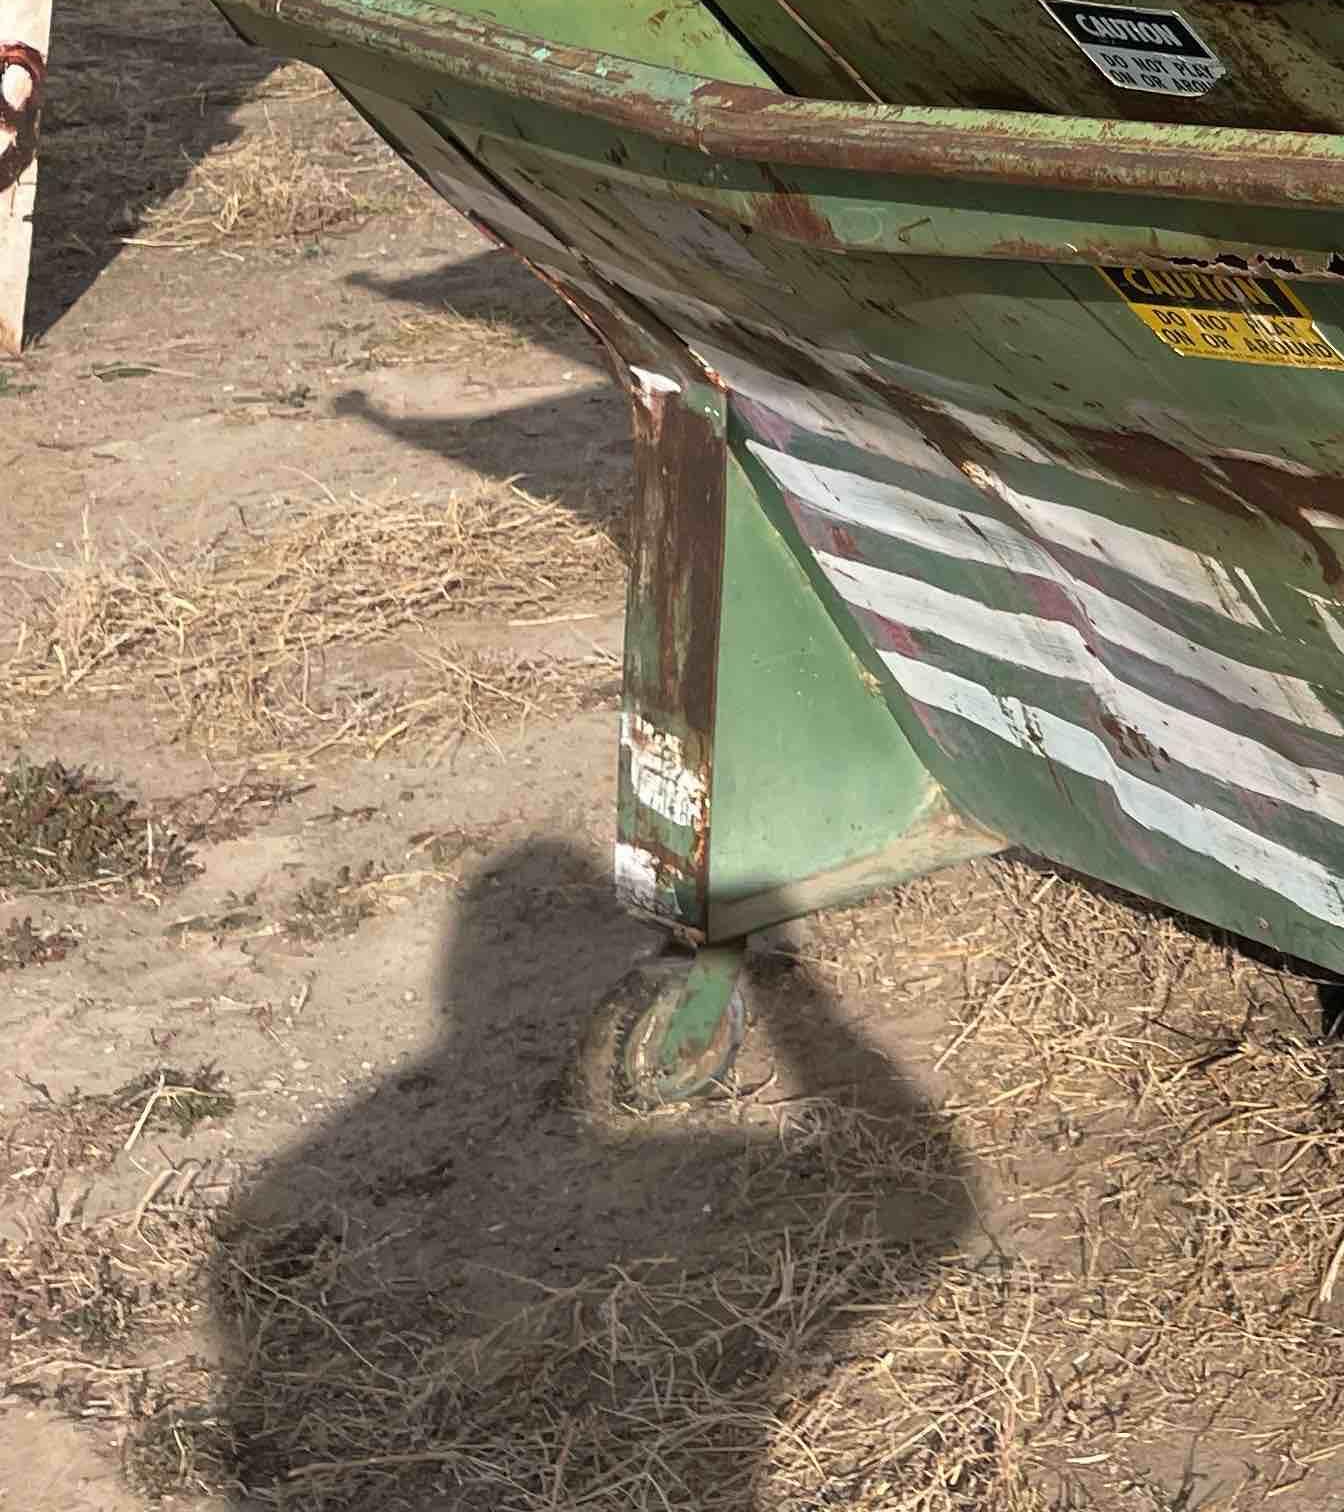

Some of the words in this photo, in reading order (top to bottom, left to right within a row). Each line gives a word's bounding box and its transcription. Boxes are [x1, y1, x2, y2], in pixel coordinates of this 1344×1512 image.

[1075, 14, 1184, 47] CAUTION
[1100, 52, 1128, 69] DO
[1131, 56, 1169, 74] NOT
[1173, 61, 1214, 79] PLAY
[1109, 70, 1137, 85] ON
[1140, 73, 1168, 89] OR
[1124, 267, 1274, 306] CAUTION
[1151, 308, 1187, 327] DO
[1190, 313, 1239, 332] NOT
[1247, 315, 1297, 335] PLAY
[1162, 328, 1196, 346] ON
[1201, 333, 1233, 350] OR
[1244, 338, 1332, 359] AROUND
